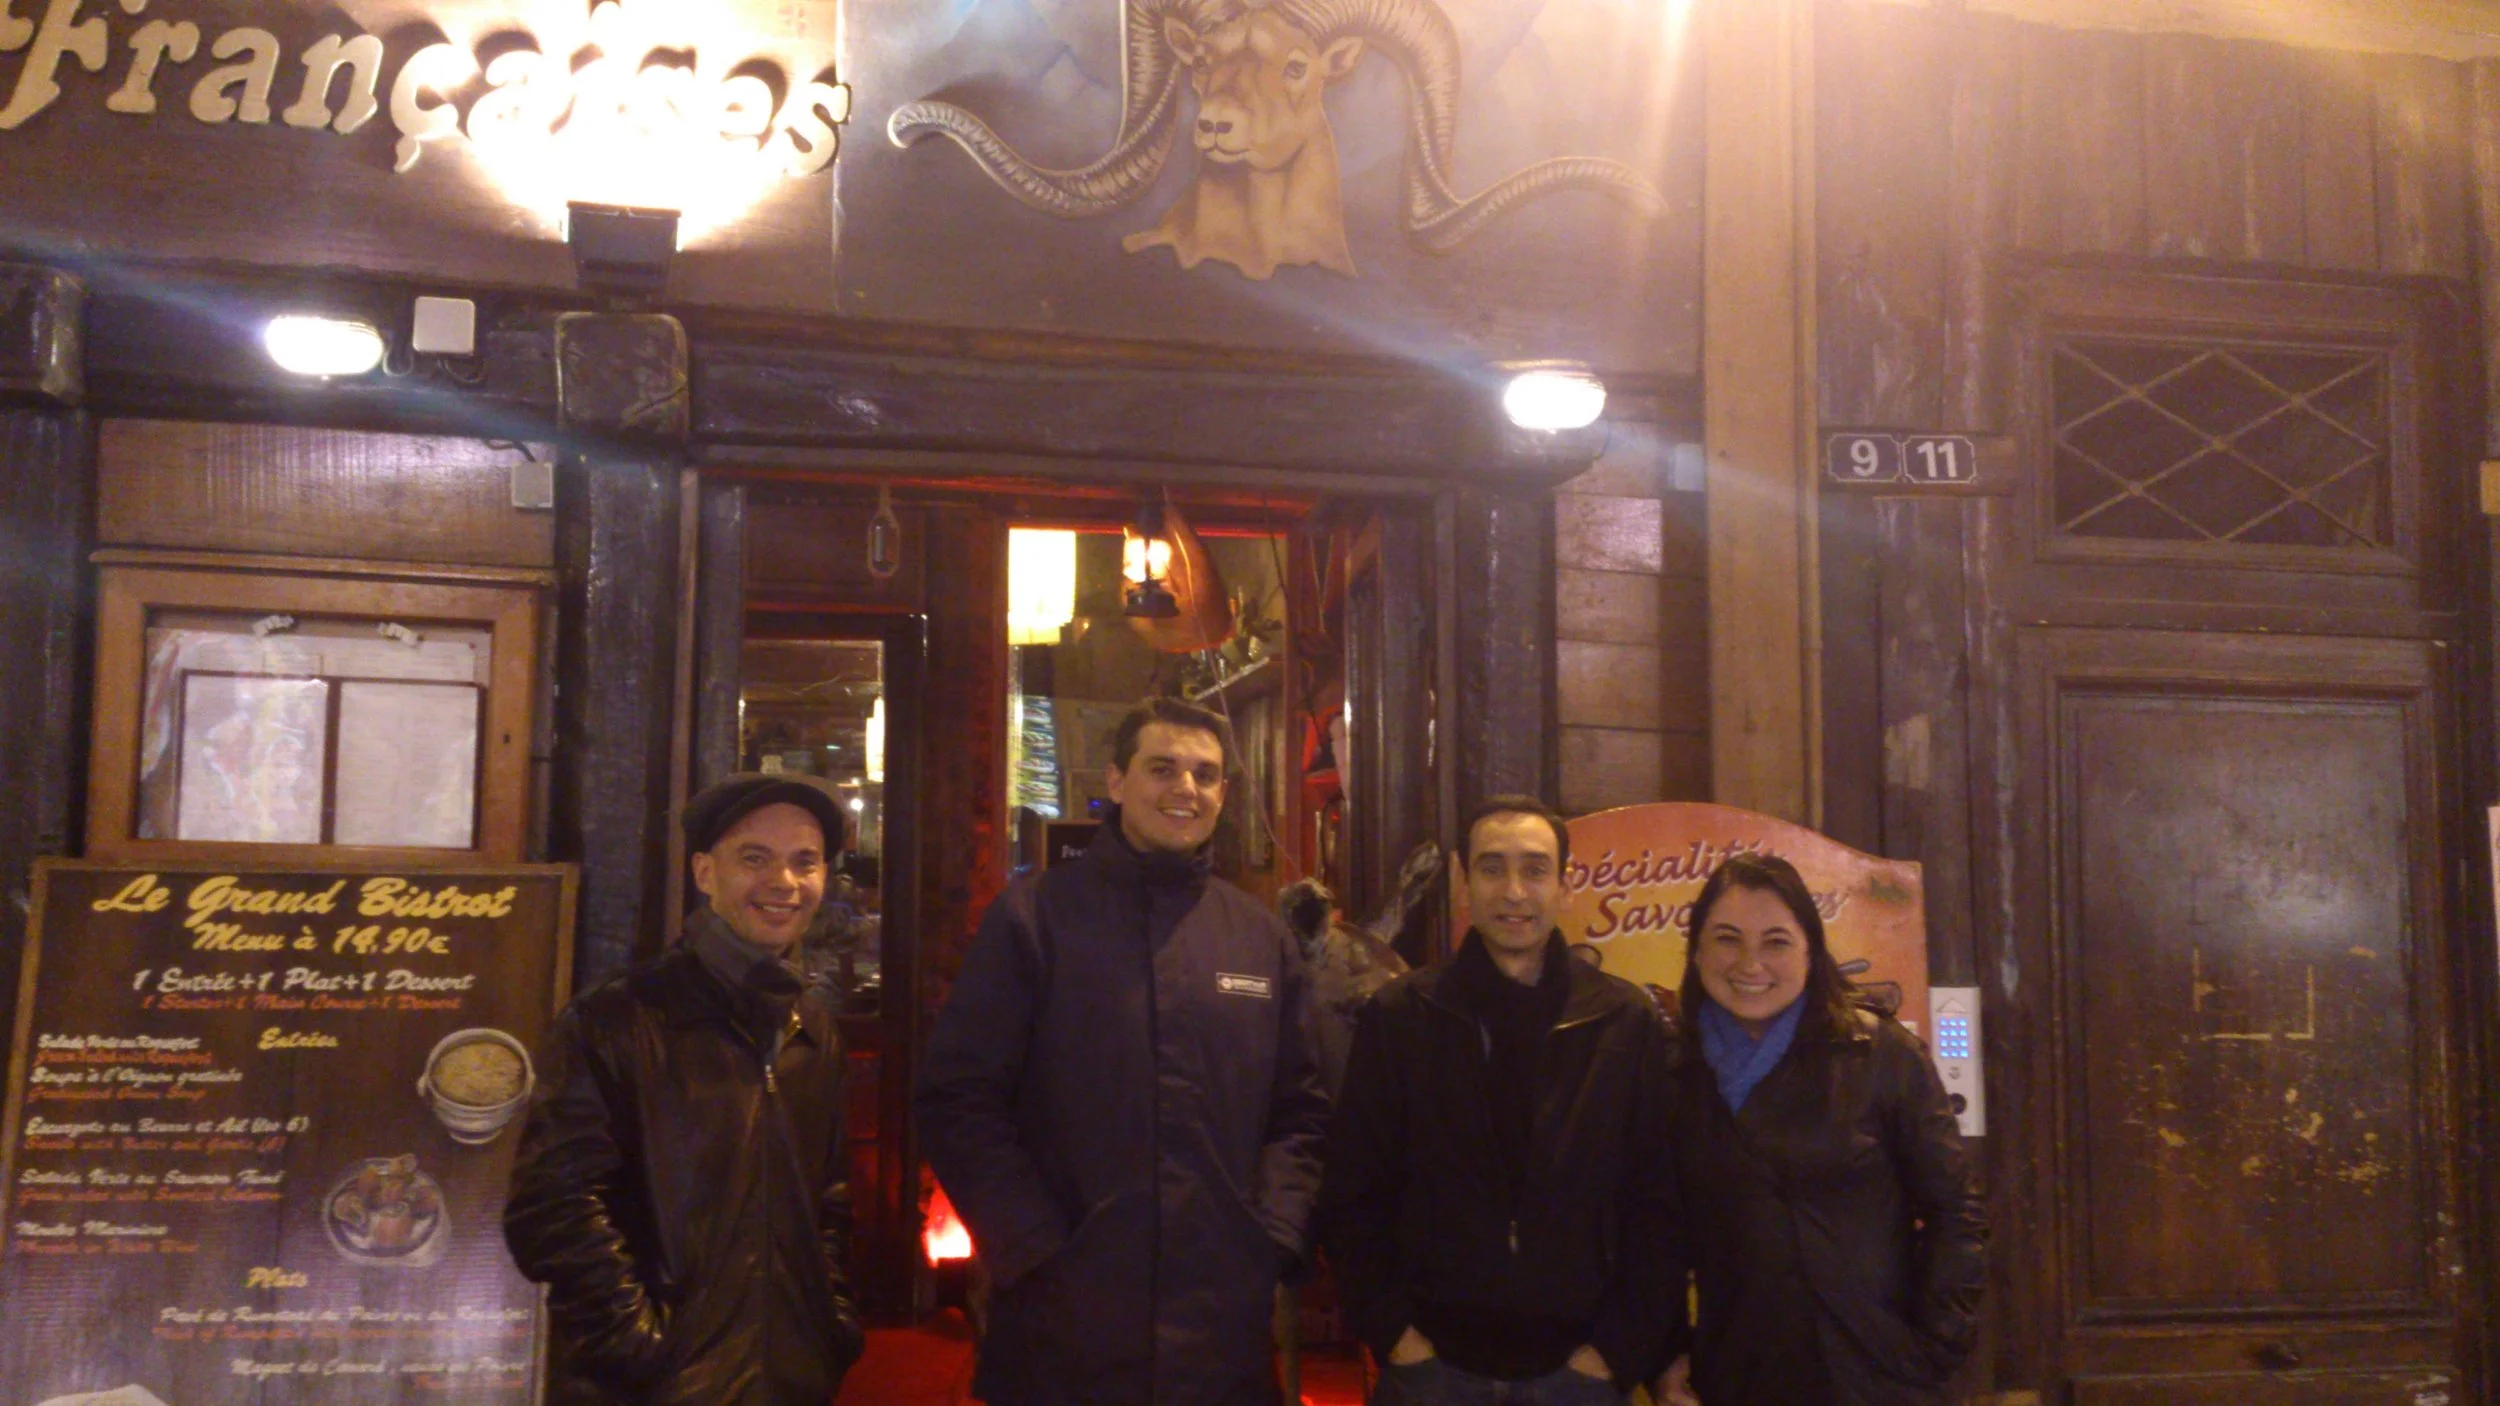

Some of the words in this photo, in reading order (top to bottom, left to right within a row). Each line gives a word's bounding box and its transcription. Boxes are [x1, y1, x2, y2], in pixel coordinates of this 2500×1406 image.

[1850, 438, 1879, 477] 9
[1917, 441, 1958, 478] 11
[92, 873, 171, 912] Le
[184, 875, 347, 928] Grand
[357, 876, 518, 919] Bistrot
[193, 922, 286, 950] Menu
[292, 925, 318, 950] à
[132, 969, 152, 991] 1
[384, 968, 476, 991] Dessert
